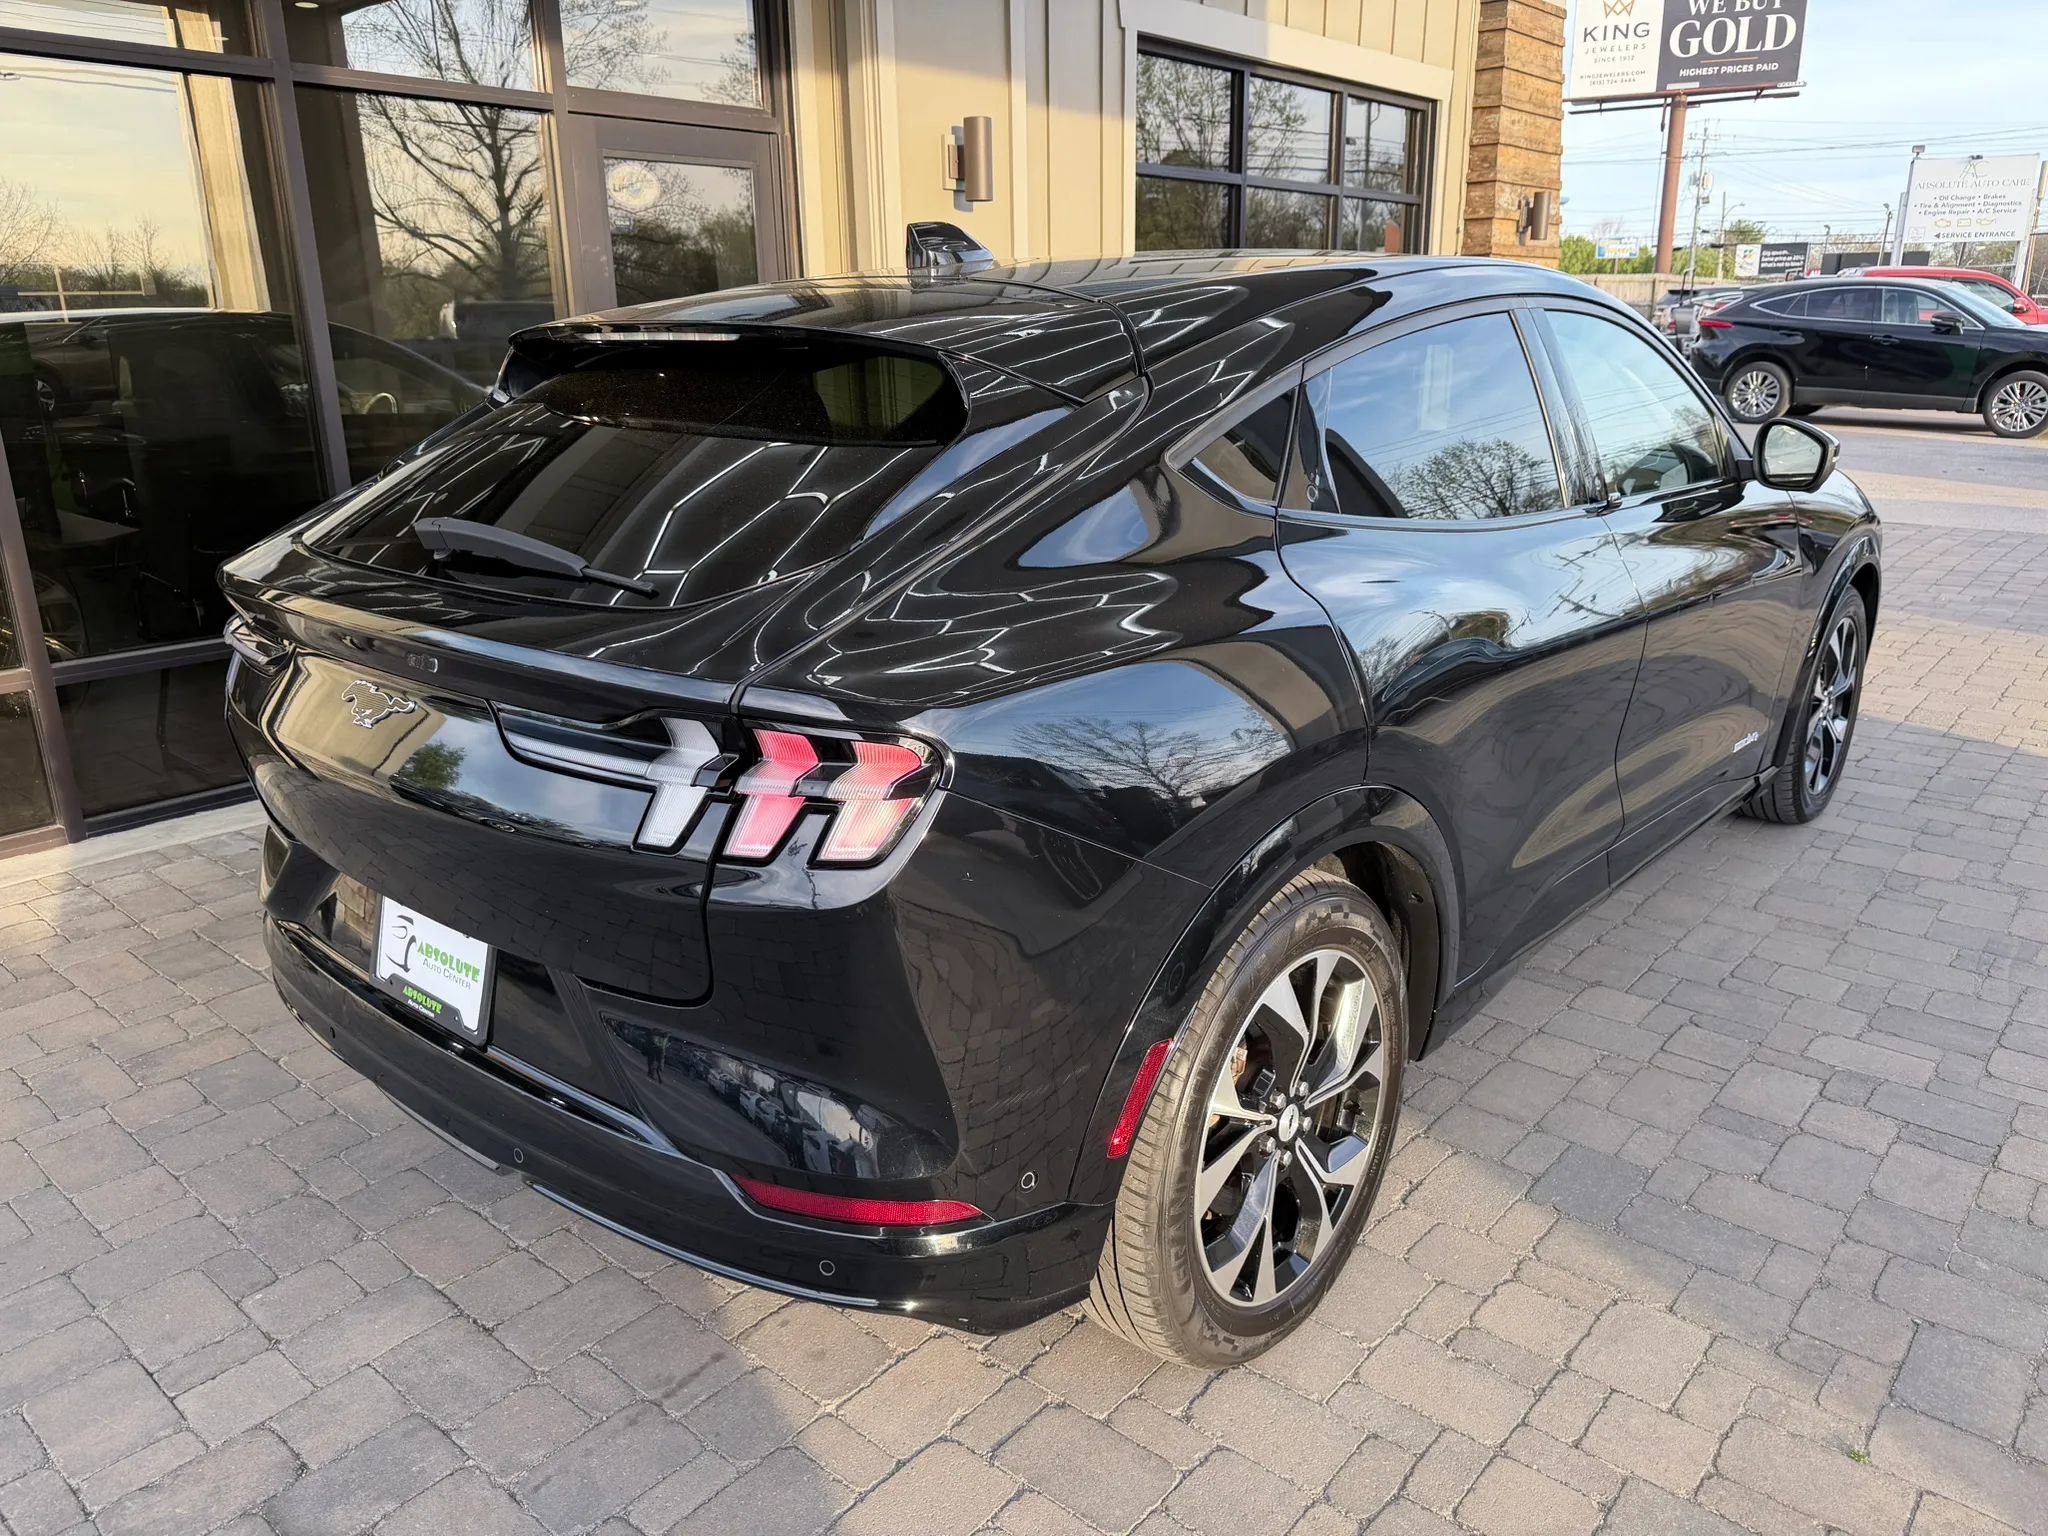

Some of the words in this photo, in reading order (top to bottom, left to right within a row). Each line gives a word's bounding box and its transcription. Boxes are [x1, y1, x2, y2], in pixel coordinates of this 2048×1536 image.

[1688, 0, 1727, 16] WE
[1583, 22, 1651, 42] KING
[1669, 13, 1797, 58] GOLD
[1584, 43, 1647, 55] JEWELERS
[1594, 55, 1617, 64] SINCE
[1580, 70, 1646, 79] INGJEWELESCOM
[1679, 66, 1719, 77] HIGHEST
[1720, 64, 1754, 75] PRICES
[1756, 62, 1779, 72] PAID
[1915, 179, 1970, 190] ABSOLUTE
[1970, 179, 2000, 188] AUTO
[2001, 177, 2030, 187] CARE
[1950, 194, 1976, 202] Change
[1941, 201, 1975, 209] Alignment
[1982, 200, 2022, 208] Diagnostics
[1923, 209, 1946, 217] Engine
[1948, 208, 1970, 216] Repair
[1941, 231, 1972, 239] SERVICE
[1974, 230, 2016, 238] ENTRANCE
[417, 941, 481, 983] ABSOLUTE
[402, 985, 443, 1015] ABSOLUTE
